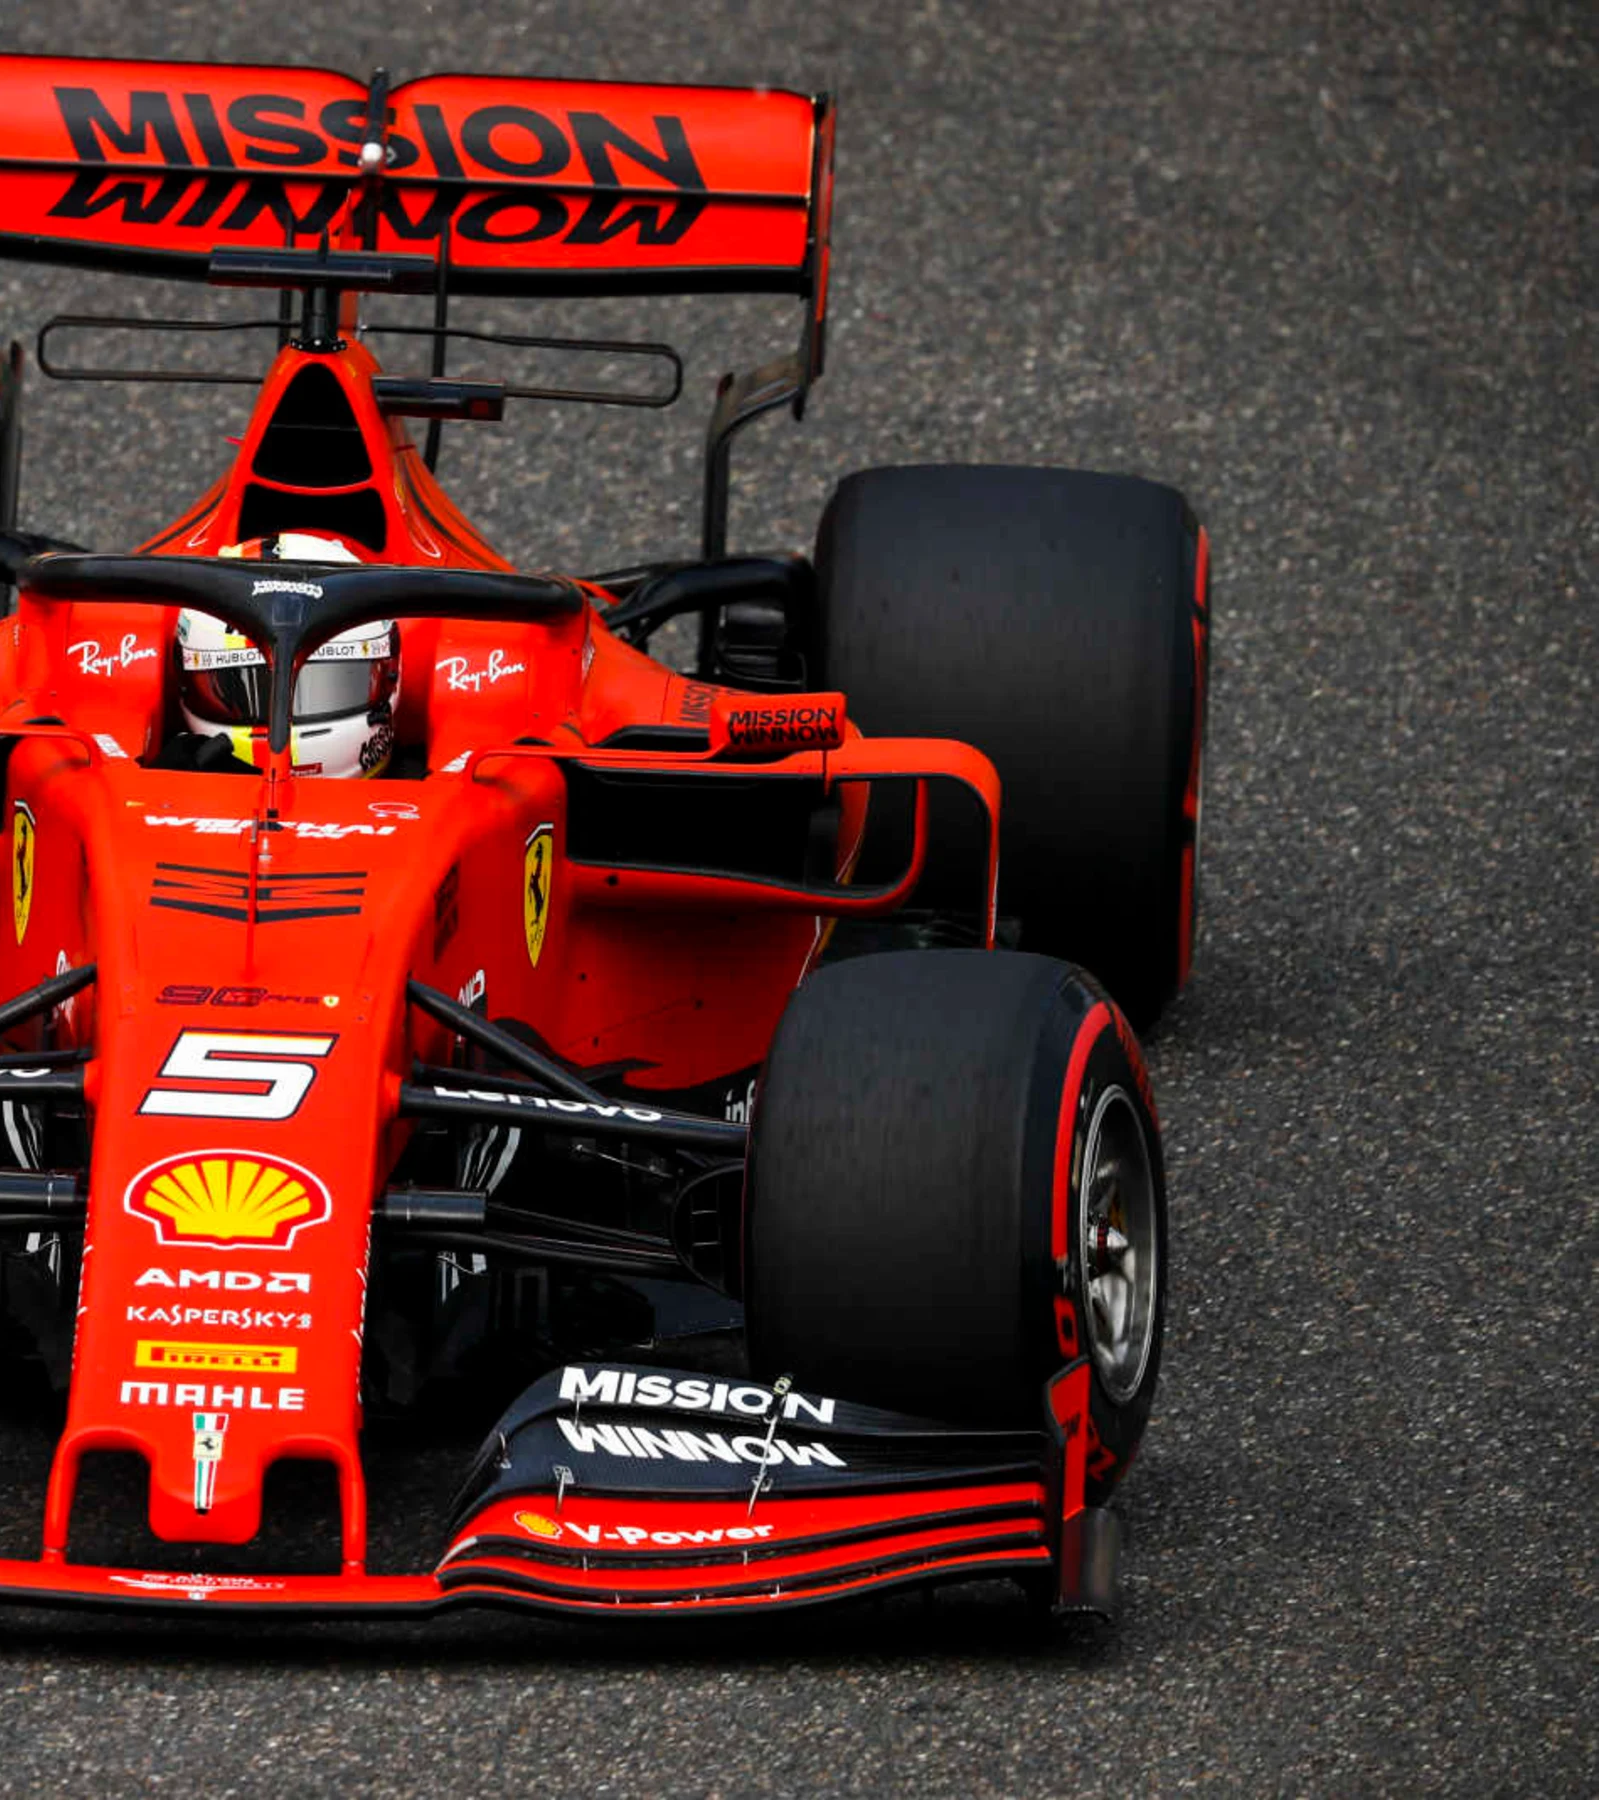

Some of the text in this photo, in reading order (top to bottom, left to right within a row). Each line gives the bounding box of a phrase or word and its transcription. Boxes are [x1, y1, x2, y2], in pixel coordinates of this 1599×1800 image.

[51, 86, 711, 193] MISSION
[67, 634, 157, 677] Ray-Ban
[435, 649, 525, 691] Ray-Ban
[729, 706, 837, 728] MISSION
[728, 725, 840, 745] WINNOW
[135, 1026, 340, 1121] 5
[134, 1267, 263, 1290] AMD
[126, 1305, 290, 1329] KASPERSKY
[120, 1381, 306, 1410] MAHLE
[558, 1366, 835, 1425] MISSION
[556, 1417, 848, 1468] WINNOW
[564, 1521, 776, 1545] V-Power
